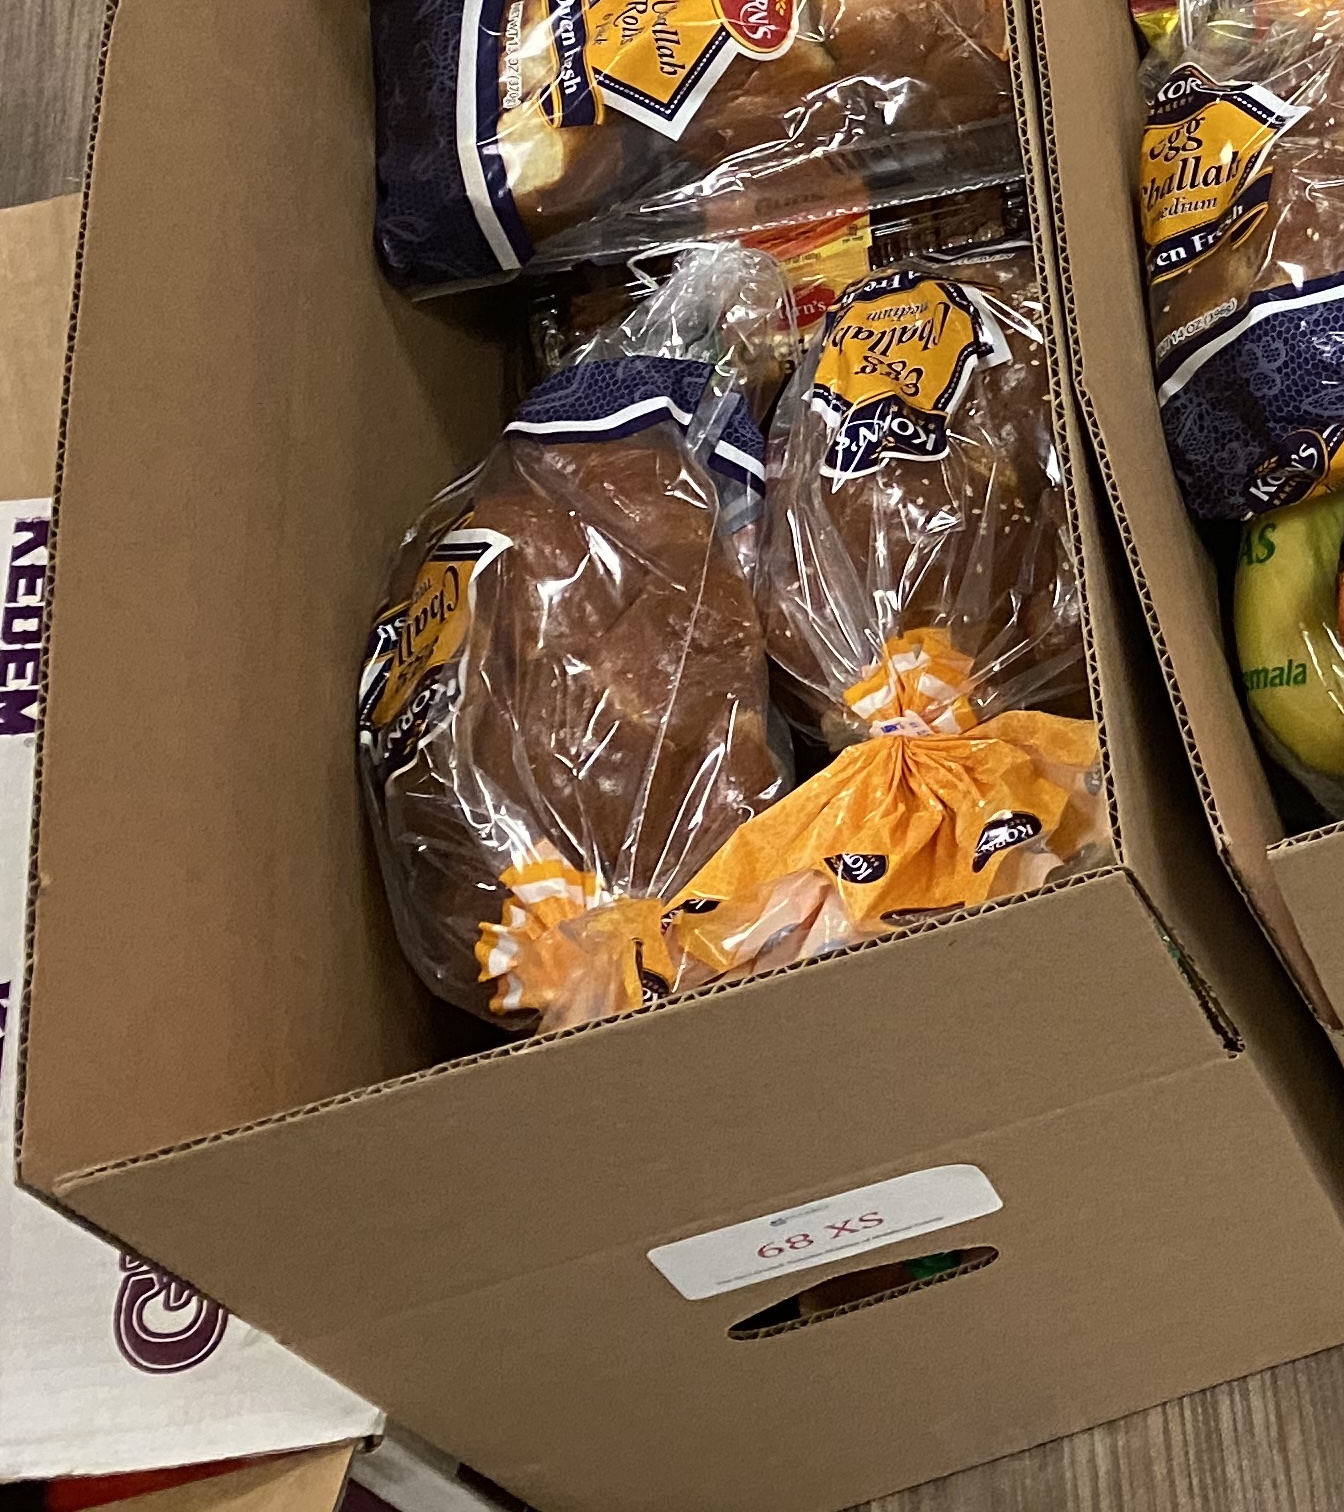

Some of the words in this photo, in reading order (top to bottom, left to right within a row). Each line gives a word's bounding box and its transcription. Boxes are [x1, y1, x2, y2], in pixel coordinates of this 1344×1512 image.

[1157, 195, 1219, 222] edium
[854, 353, 926, 398] Egg
[1249, 444, 1318, 502] KON'S
[0, 520, 50, 736] KEDEM
[757, 1232, 814, 1260] 68
[824, 1210, 885, 1240] XS
